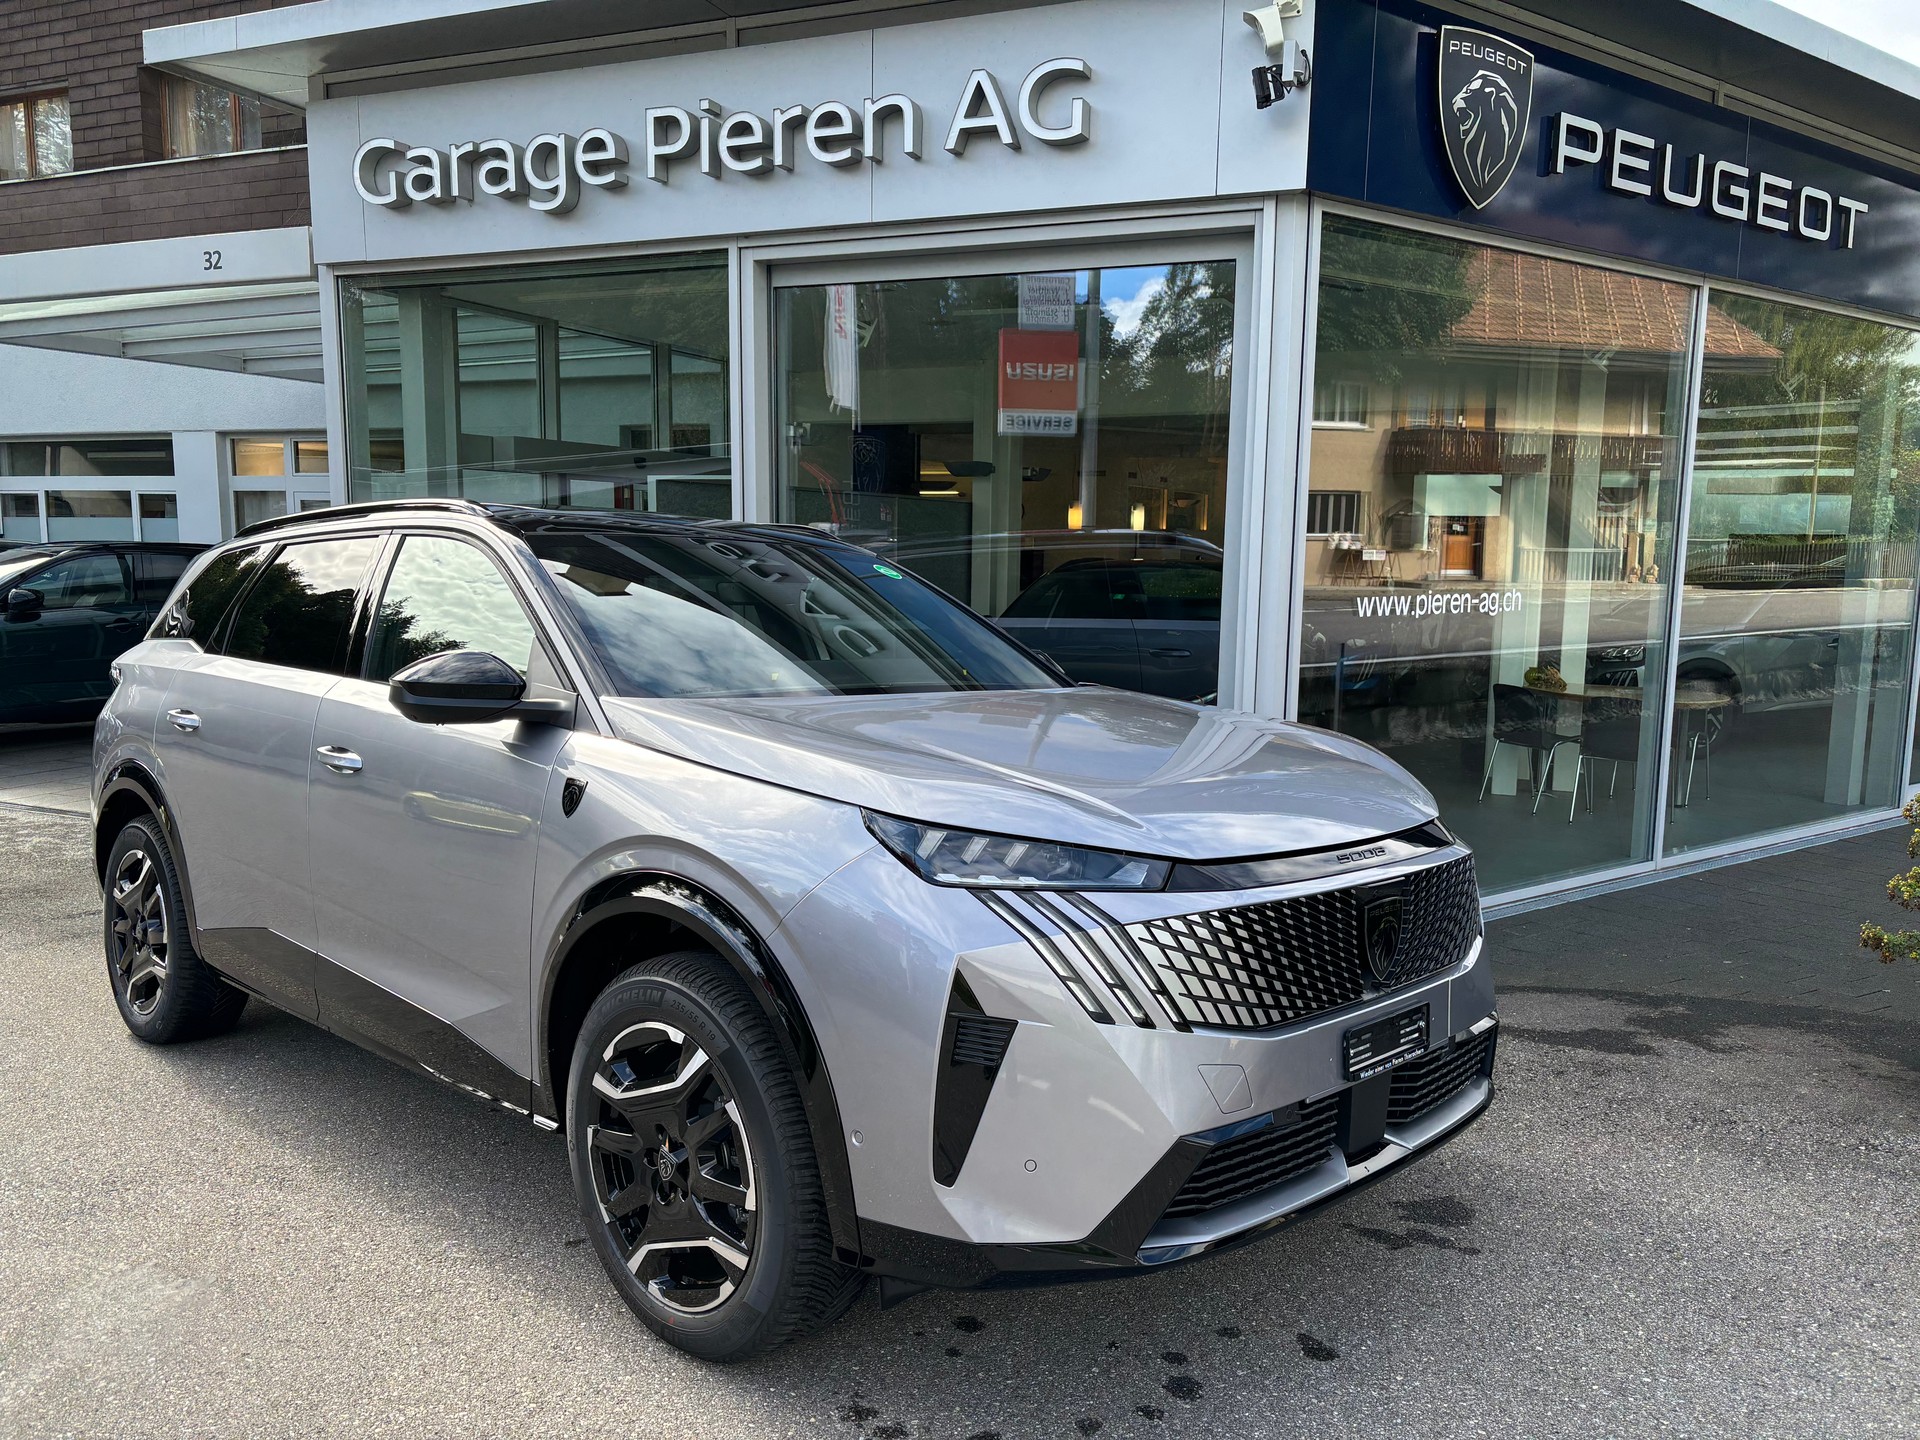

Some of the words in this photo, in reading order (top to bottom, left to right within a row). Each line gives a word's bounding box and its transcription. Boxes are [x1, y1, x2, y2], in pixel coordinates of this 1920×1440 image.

[1449, 40, 1527, 75] PEUGEOT
[352, 127, 629, 213] Garage
[645, 93, 923, 183] Pieren
[944, 57, 1091, 155] AG
[1556, 111, 1869, 249] PEUGEOT
[203, 250, 223, 271] 32
[1357, 588, 1522, 618] www.pieren-ag.ch
[1336, 846, 1387, 864] 5008
[670, 999, 699, 1023] 235/55
[699, 1021, 706, 1031] R
[706, 1030, 717, 1041] 19
